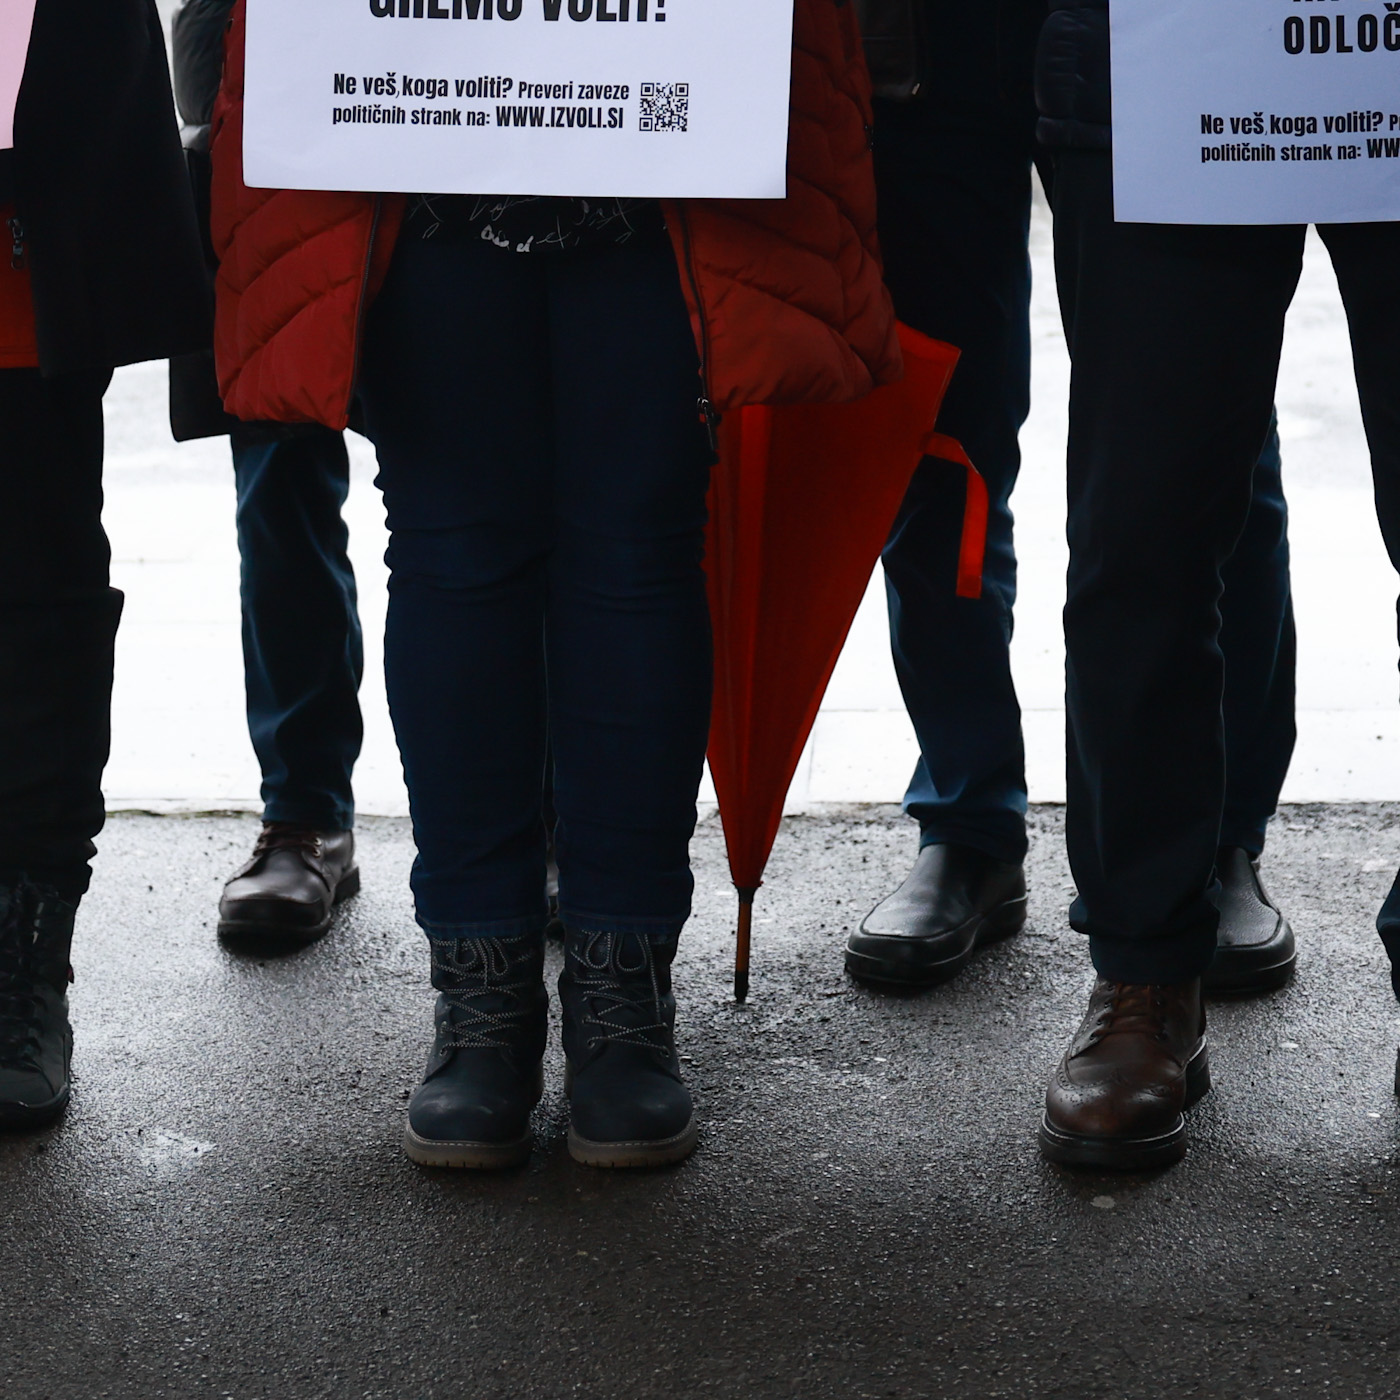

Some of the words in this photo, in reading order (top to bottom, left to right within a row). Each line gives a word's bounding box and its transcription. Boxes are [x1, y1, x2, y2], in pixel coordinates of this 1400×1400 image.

[334, 74, 356, 94] Ne
[403, 75, 448, 99] koga
[455, 76, 513, 98] voliti?
[519, 81, 573, 99] Preveri
[578, 85, 629, 99] zaveze
[333, 104, 405, 124] političnih
[411, 108, 461, 125] strank
[467, 111, 490, 126] na:
[496, 106, 623, 128] WWW.IZVOLI.SI
[1201, 114, 1223, 134] Ne
[1270, 115, 1317, 137] koga
[1323, 111, 1383, 133] voliti?
[1202, 143, 1275, 163] političnih
[1281, 144, 1332, 161] strank
[1338, 145, 1361, 160] na:
